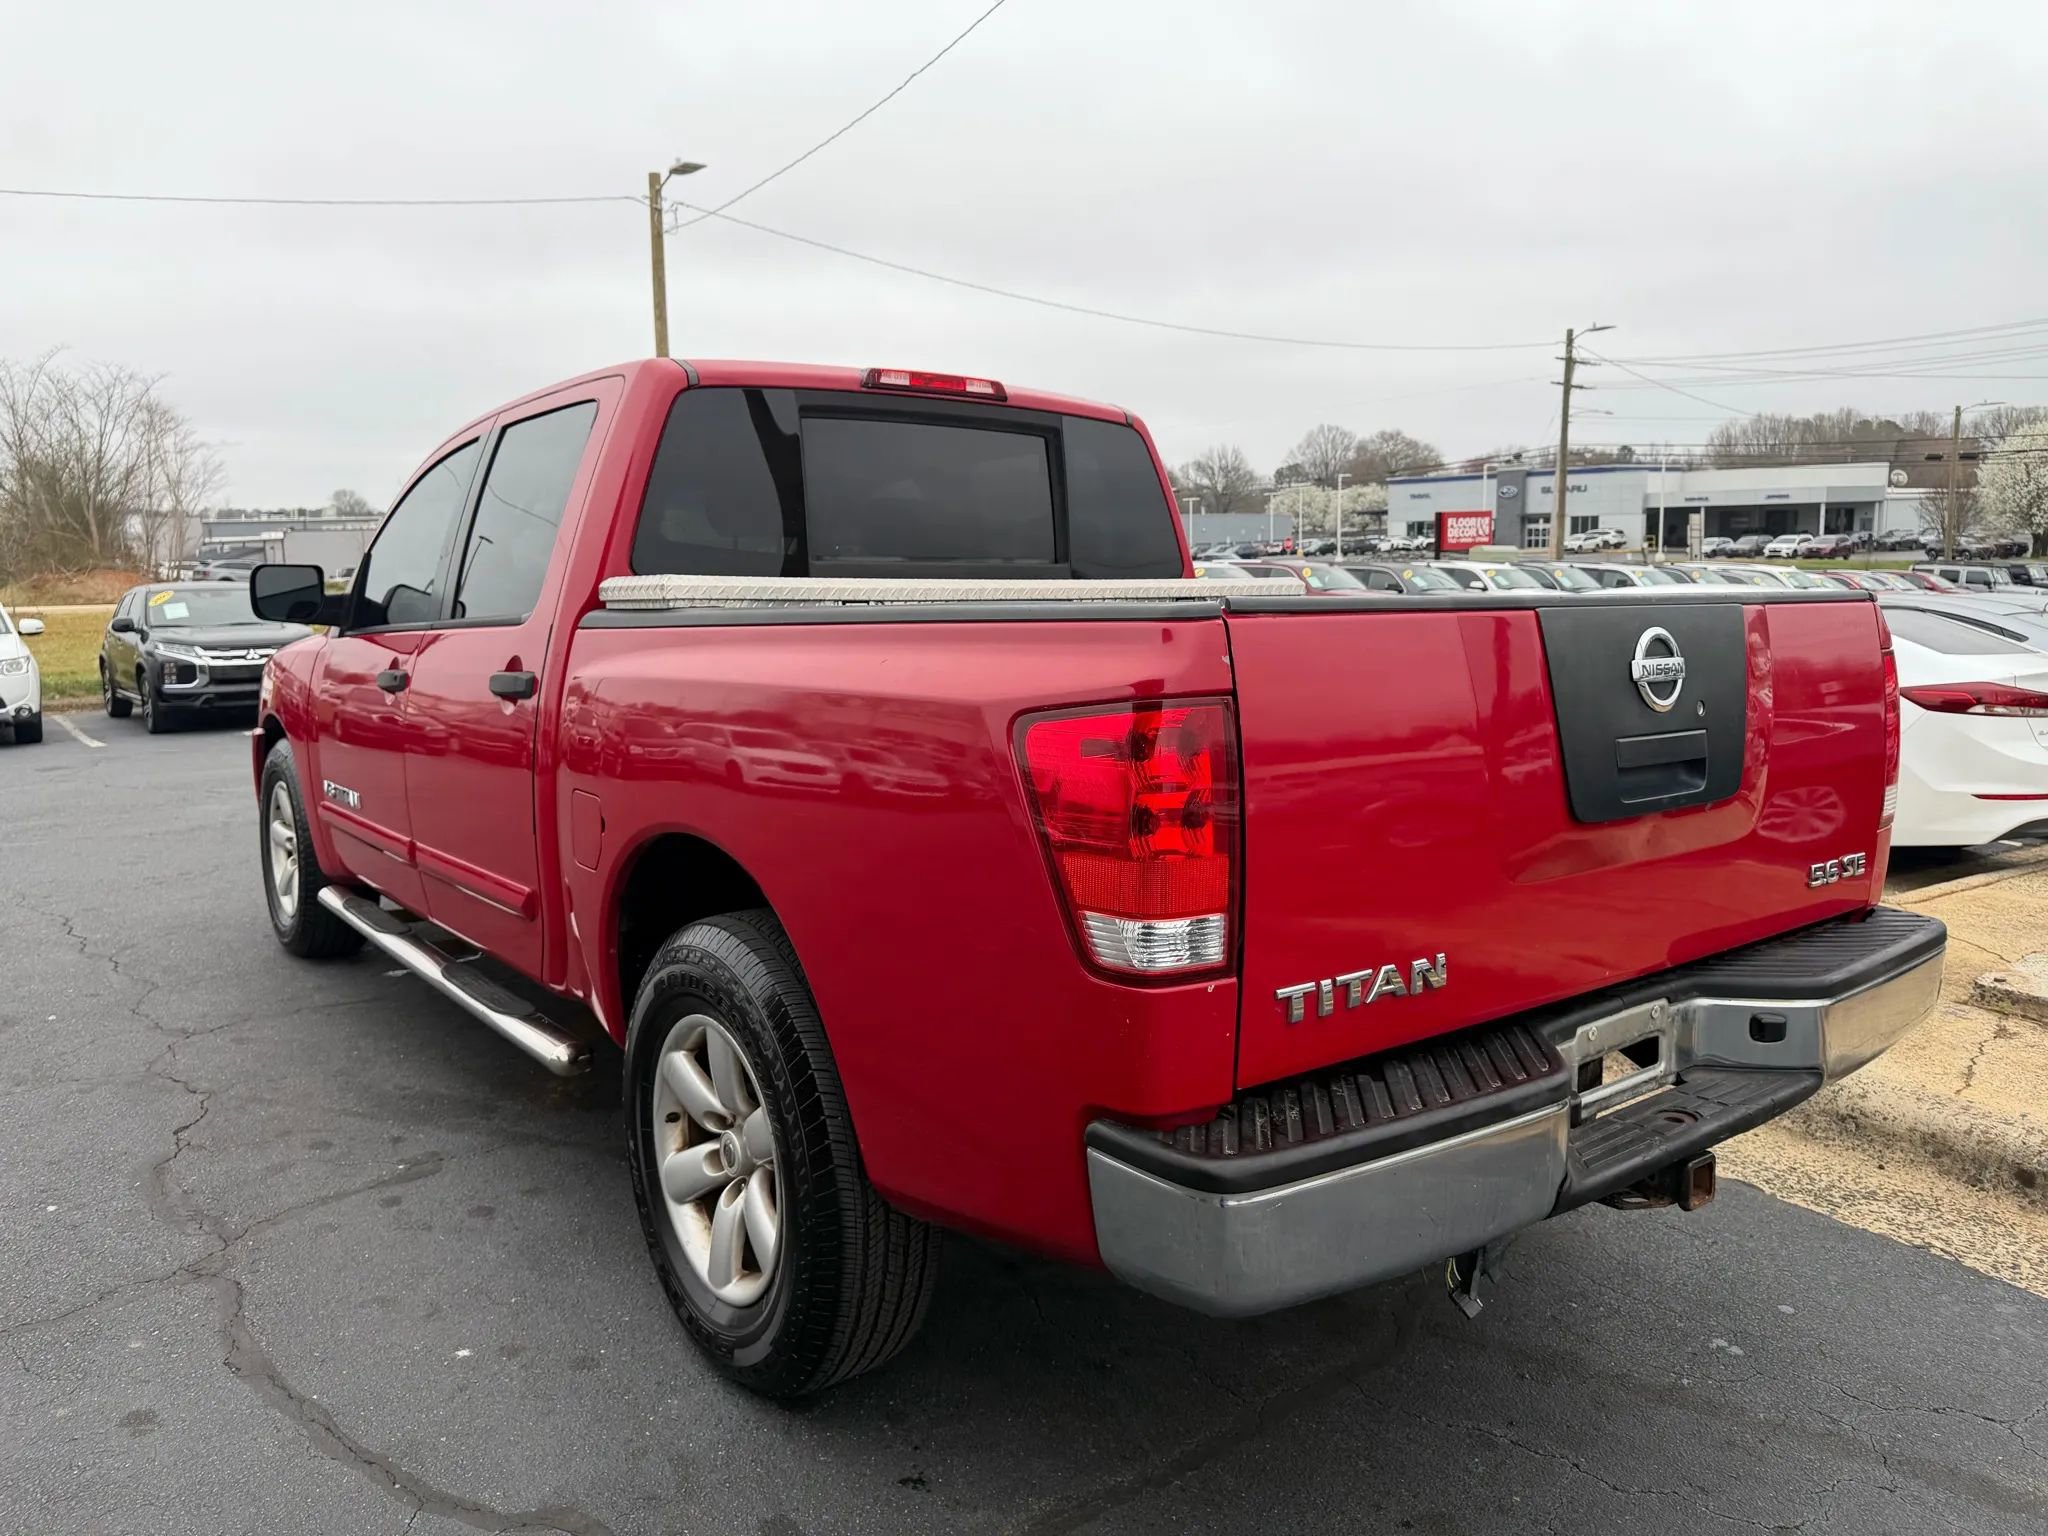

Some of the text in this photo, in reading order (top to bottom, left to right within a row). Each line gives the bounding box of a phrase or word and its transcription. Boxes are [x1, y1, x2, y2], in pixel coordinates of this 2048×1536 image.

[1541, 485, 1587, 494] SUARU
[1447, 517, 1477, 528] FLOOR
[1447, 528, 1477, 537] DECOR
[1641, 662, 1684, 677] NISSAN
[1839, 852, 1866, 878] SE
[1275, 952, 1447, 1024] TITAN
